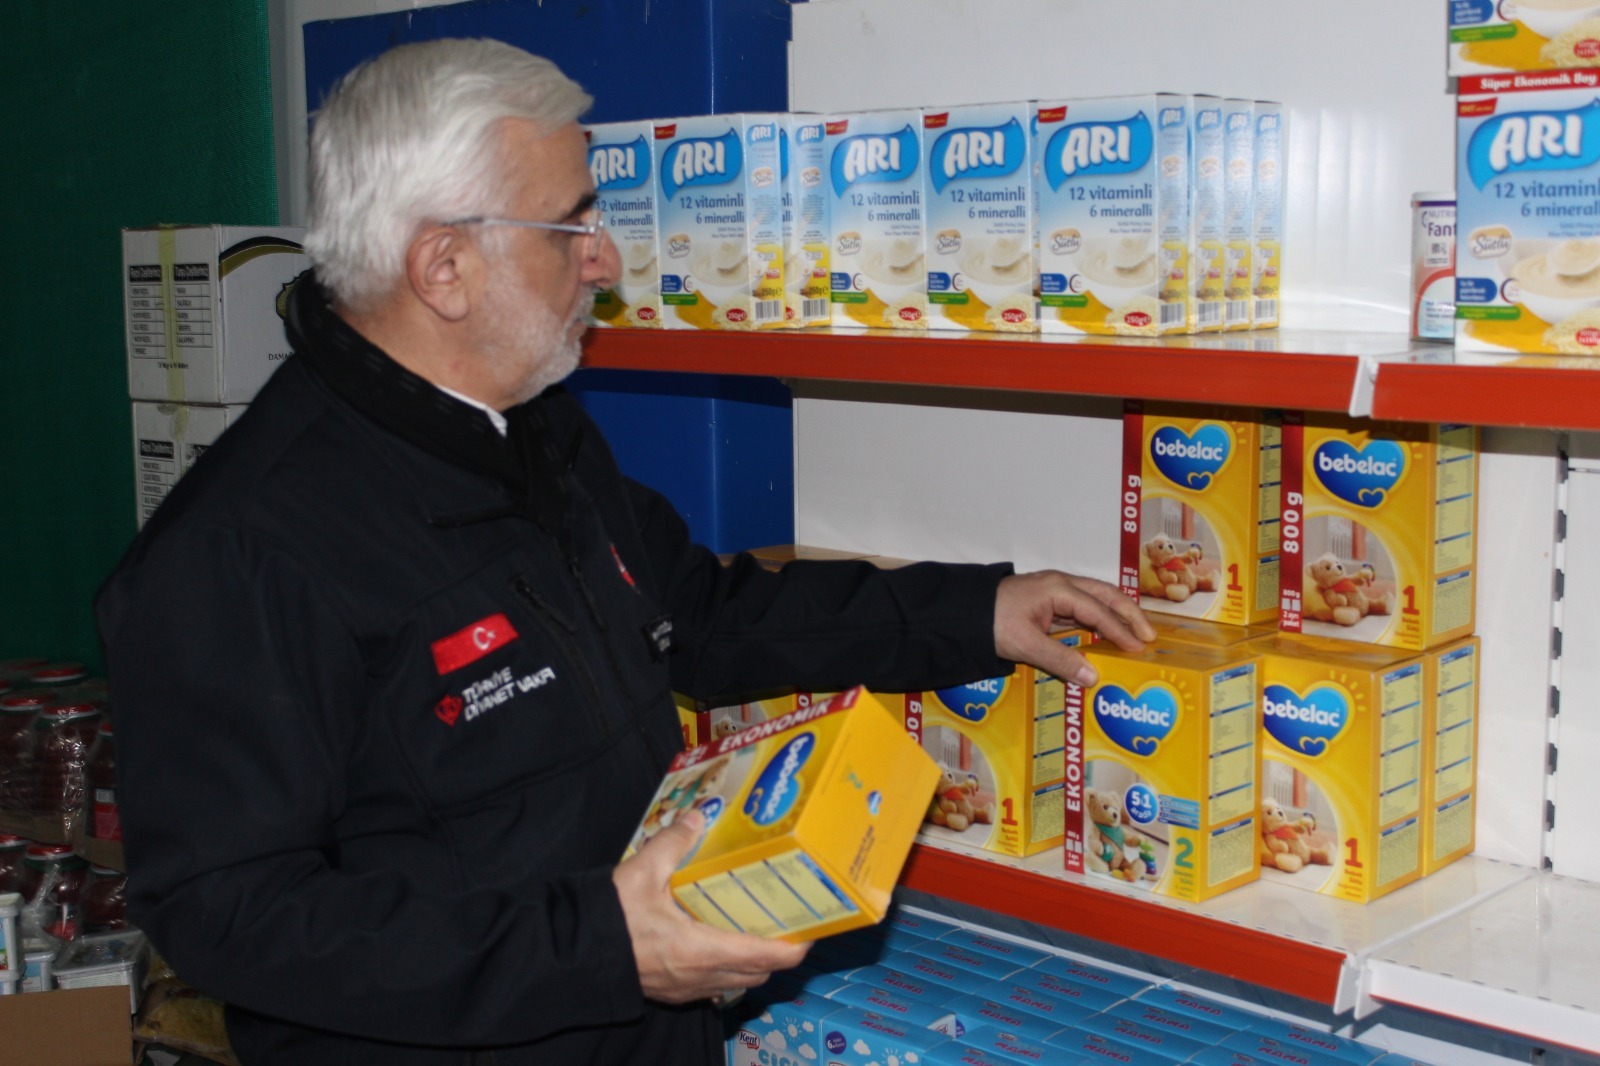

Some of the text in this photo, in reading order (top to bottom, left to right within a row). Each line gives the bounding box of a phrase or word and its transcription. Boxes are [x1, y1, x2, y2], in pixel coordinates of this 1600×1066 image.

[1481, 73, 1597, 91] Süper Ekonomik Boy
[752, 126, 771, 141] ARI
[801, 126, 819, 142] ARI
[1489, 114, 1582, 172] ARI
[843, 137, 900, 183] ARI
[943, 131, 1005, 178] ARI
[1061, 125, 1130, 176] ARI
[591, 147, 636, 188] ARI
[673, 141, 725, 186] ARI
[681, 193, 744, 209] 12 vitaminli
[851, 189, 920, 206] 12 vitaminli
[951, 185, 1025, 202] 12 vitaminli
[1070, 183, 1153, 201] 12 vitaminli
[1495, 182, 1515, 198] 12
[609, 198, 653, 211] vitaminli
[868, 208, 920, 221] 6 mineralli
[968, 205, 1026, 219] 6 mineralli
[1090, 204, 1153, 218] 6 mineralli
[1521, 202, 1531, 217] 6
[610, 213, 653, 226] 6 mineralli
[696, 211, 745, 224] 6 mineralli
[1473, 233, 1510, 254] Sütlü
[1155, 437, 1223, 462] bebelac
[1319, 452, 1397, 477] bebelac
[1124, 475, 1141, 533] 800 g
[1283, 491, 1303, 553] 800 g
[1227, 562, 1243, 592] 1
[1402, 585, 1420, 615] 1
[1098, 695, 1170, 727] bebelac
[1263, 696, 1340, 727] bebelac
[1001, 797, 1018, 827] 1
[1175, 837, 1194, 869] 2
[1344, 837, 1363, 868] 1
[740, 1032, 758, 1045] Kent
